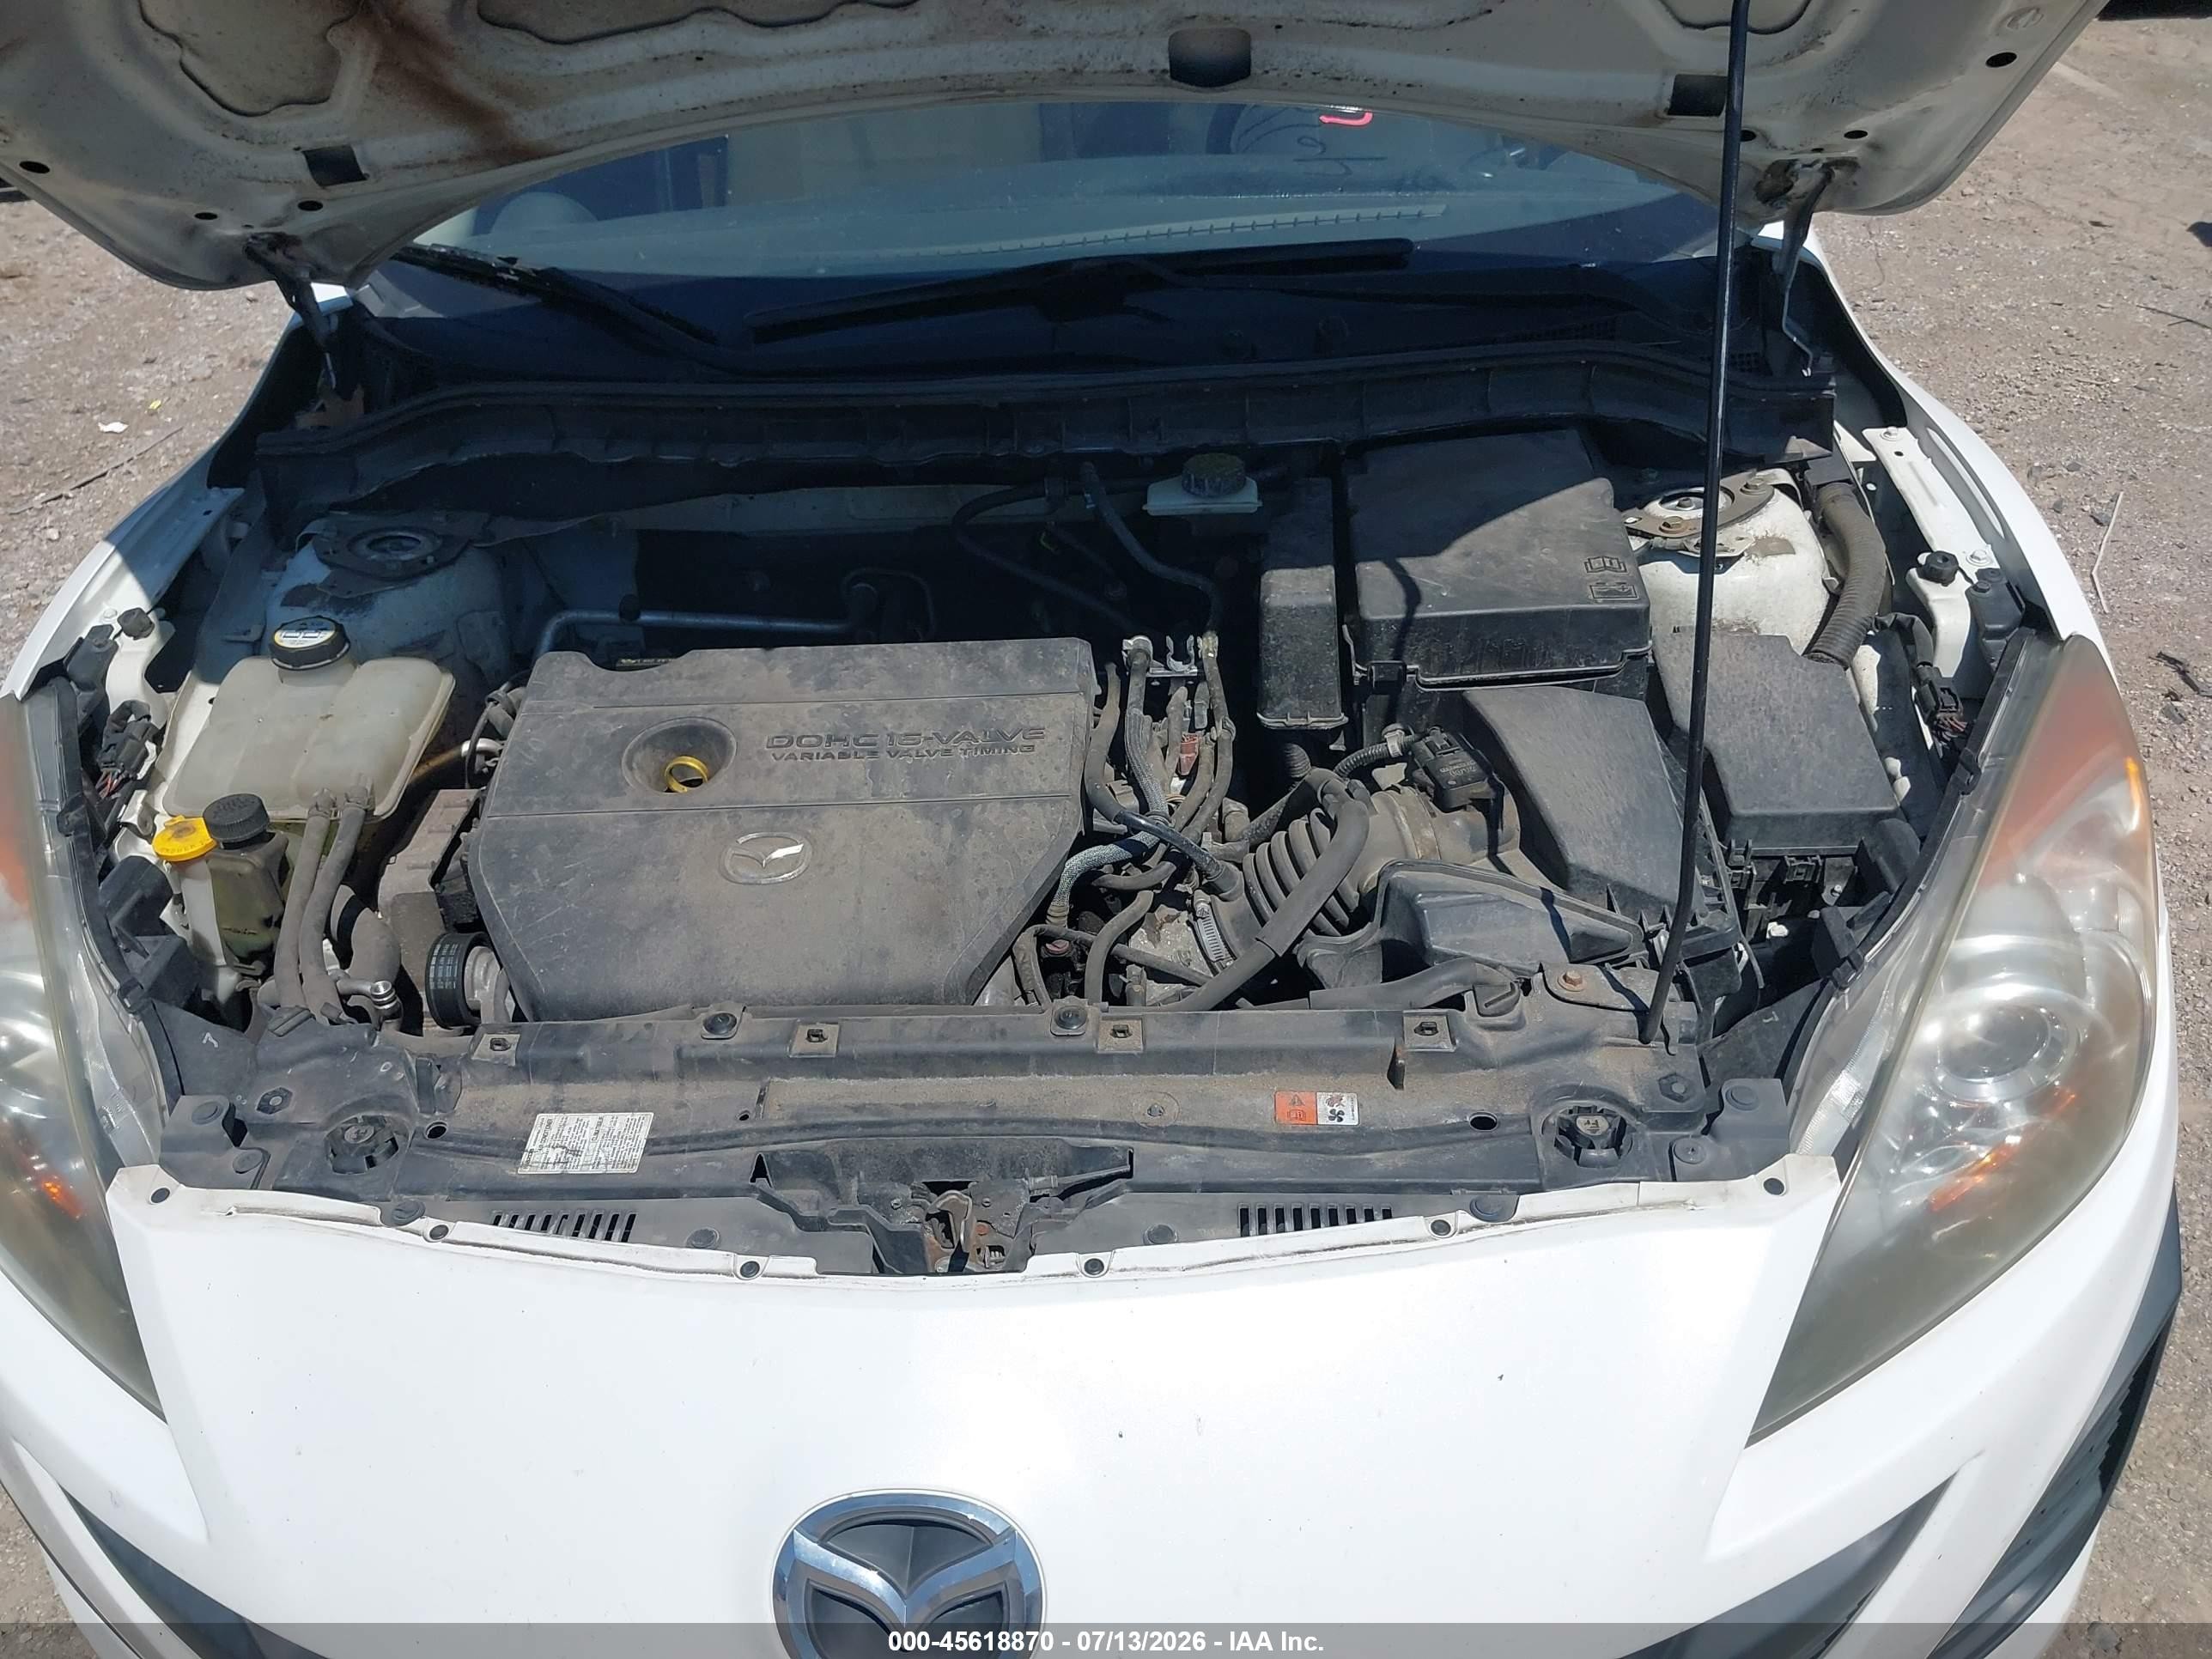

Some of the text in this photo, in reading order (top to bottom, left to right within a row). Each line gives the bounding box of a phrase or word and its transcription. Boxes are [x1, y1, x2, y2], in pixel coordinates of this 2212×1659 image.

[765, 733, 881, 750] DOHC
[771, 744, 1036, 762] VARIABLE VALVE TIMING
